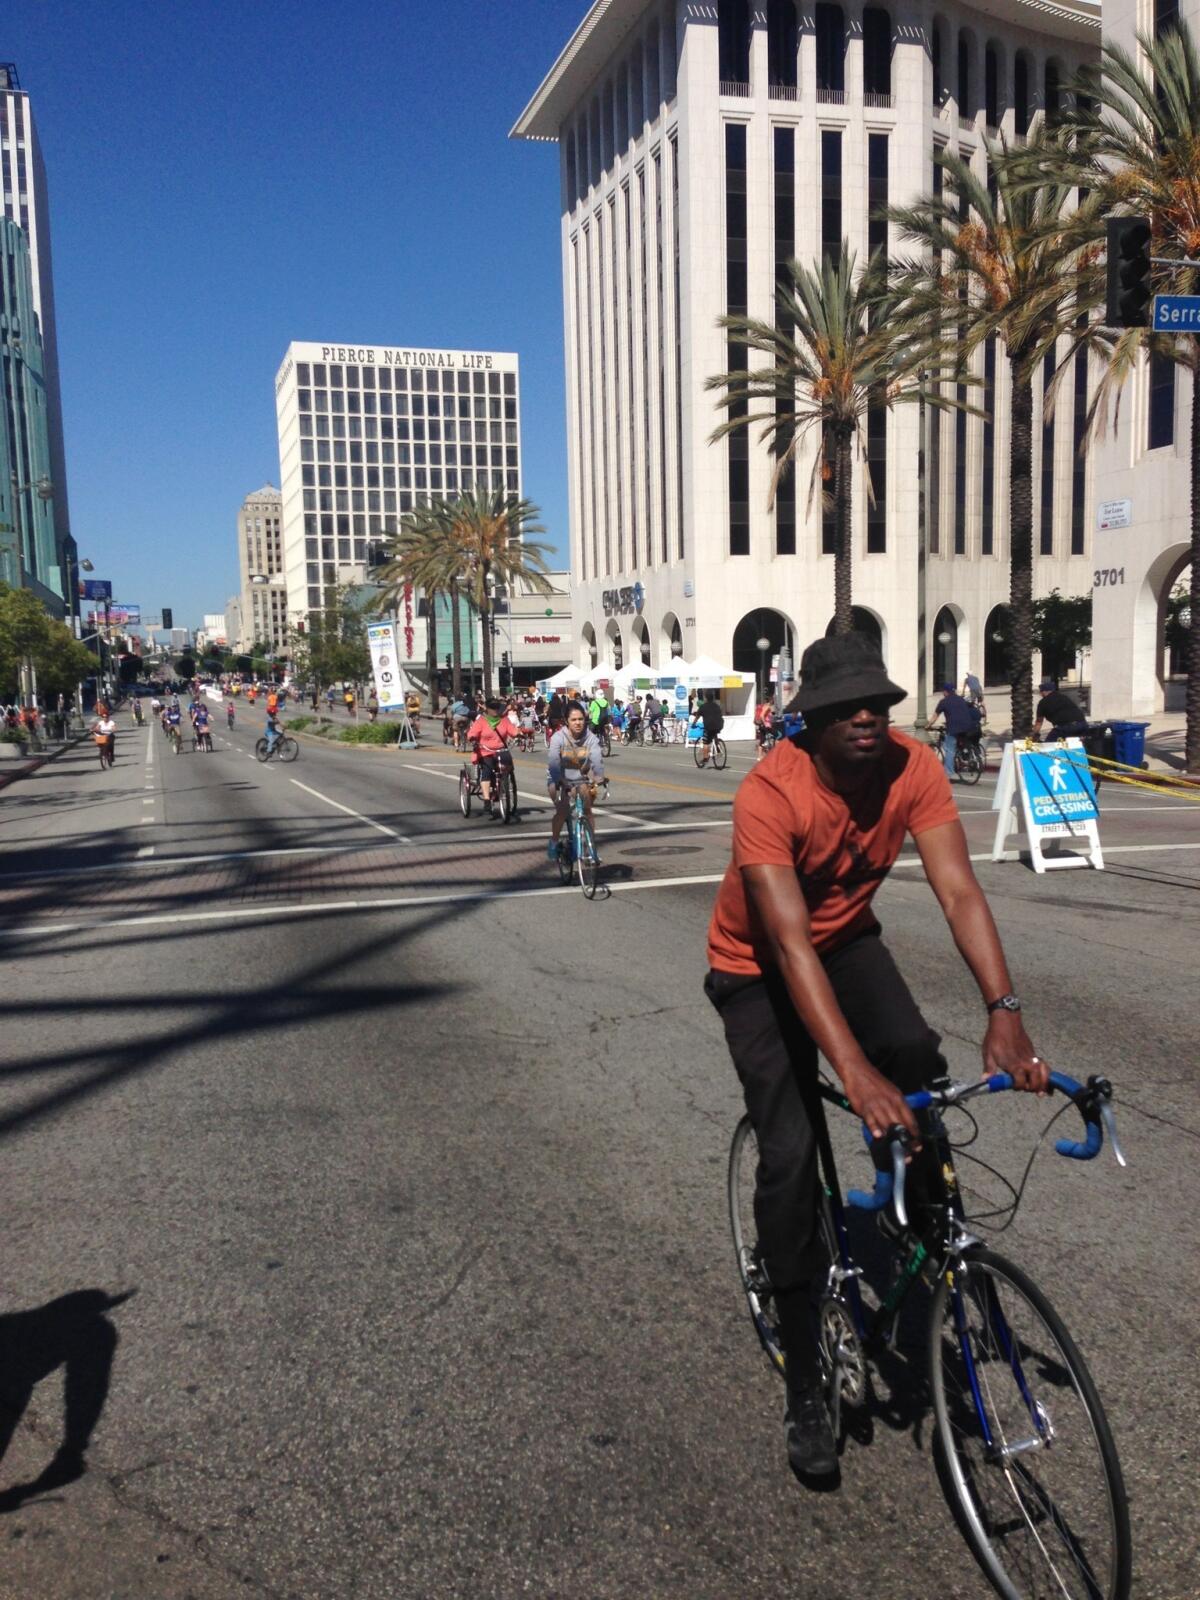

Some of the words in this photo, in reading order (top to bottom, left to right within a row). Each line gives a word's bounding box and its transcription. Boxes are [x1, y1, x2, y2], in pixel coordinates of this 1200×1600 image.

[322, 346, 375, 363] PIERCE
[384, 351, 454, 367] NATIONAL
[462, 354, 493, 369] LIFE
[1093, 567, 1125, 587] 3701
[602, 586, 636, 609] CHASE
[1033, 791, 1090, 806] PEDESTRIAN
[1034, 800, 1095, 817] CROSSING
